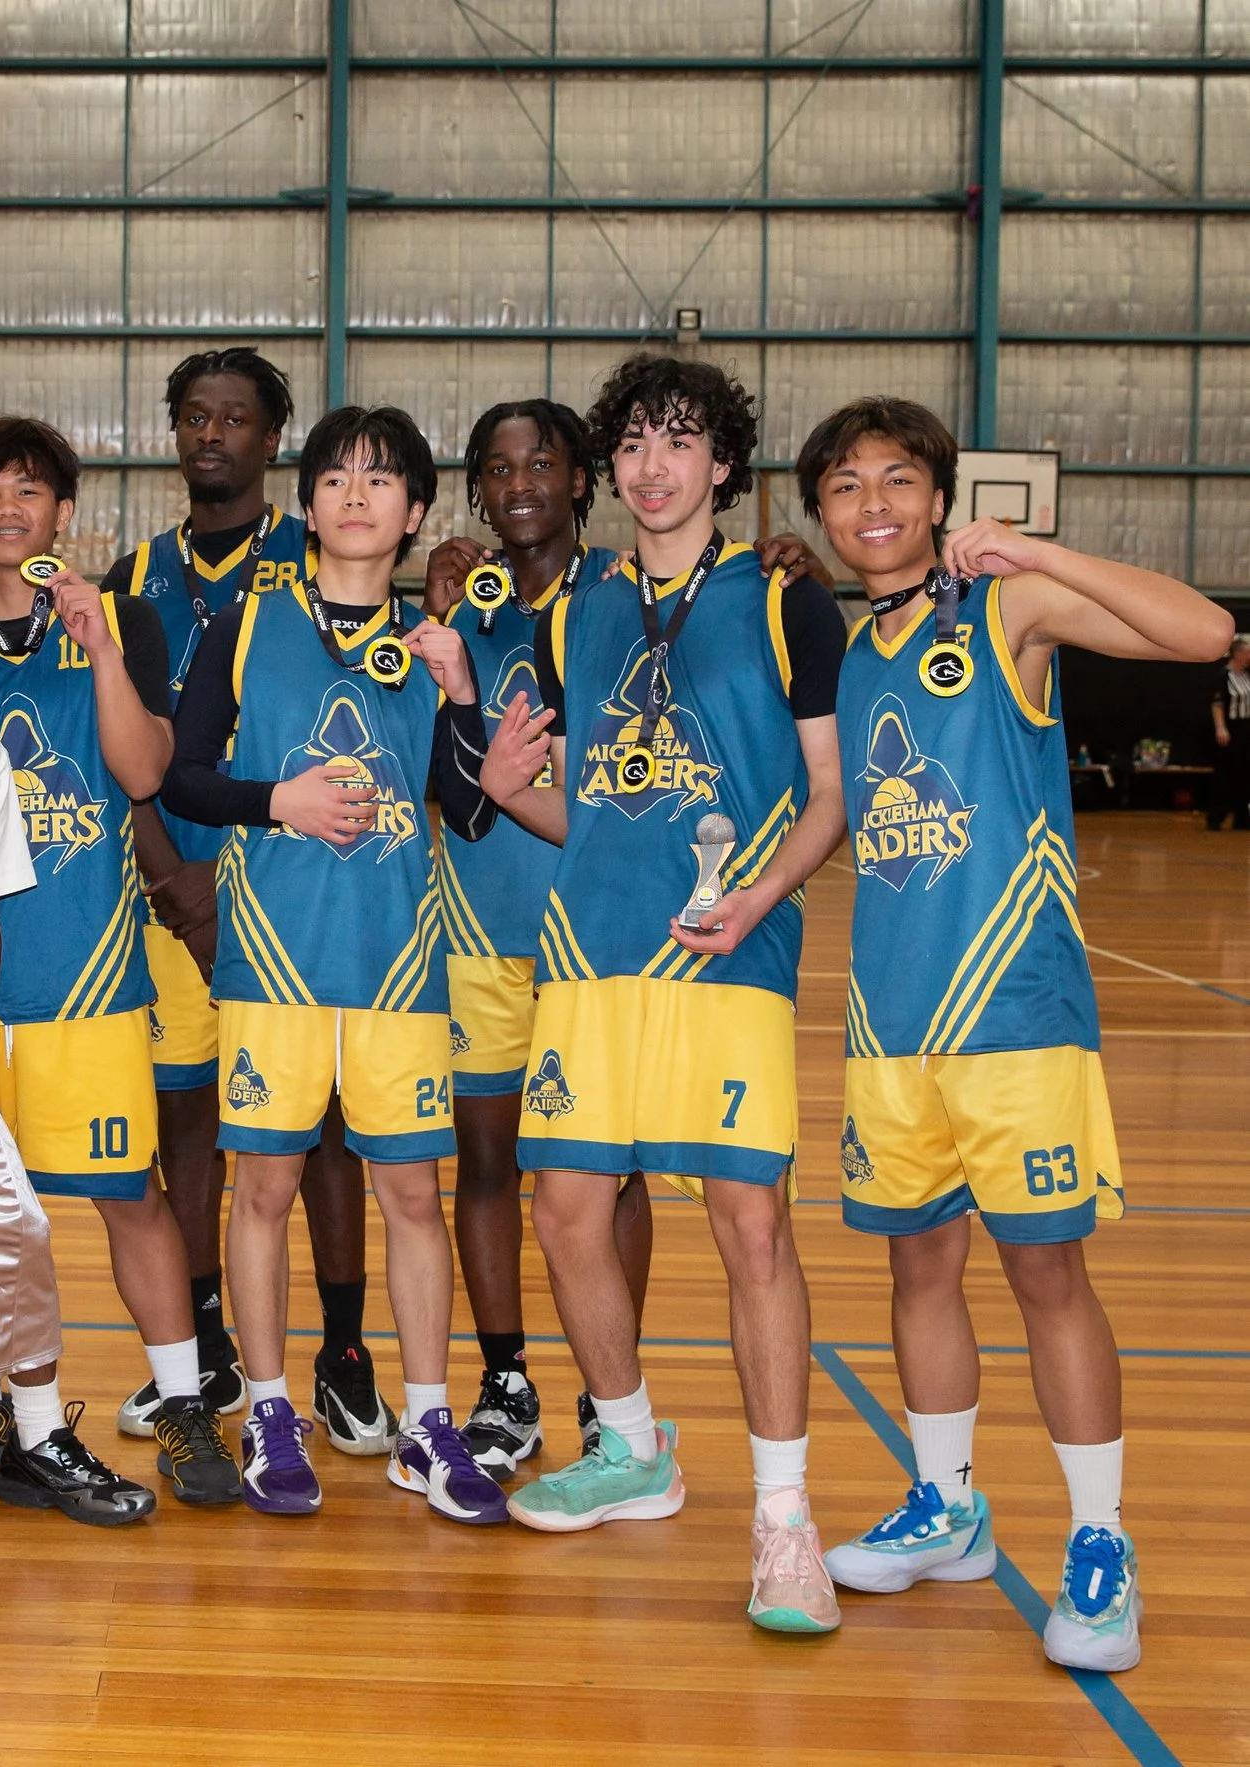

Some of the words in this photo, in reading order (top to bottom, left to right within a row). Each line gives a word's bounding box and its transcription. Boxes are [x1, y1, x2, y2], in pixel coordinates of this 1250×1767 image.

[253, 560, 298, 593] 28
[567, 555, 581, 584] PACERS
[684, 566, 706, 602] PACERS
[313, 602, 328, 631] PACERS
[330, 619, 365, 630] 2XU
[58, 633, 91, 670] 10
[862, 798, 950, 831] ICKLEHAM
[416, 1074, 450, 1119] 24
[523, 1095, 576, 1114] RAIDERS
[721, 1079, 747, 1129] 7
[89, 1116, 128, 1159] 10
[1023, 1143, 1078, 1197] 63
